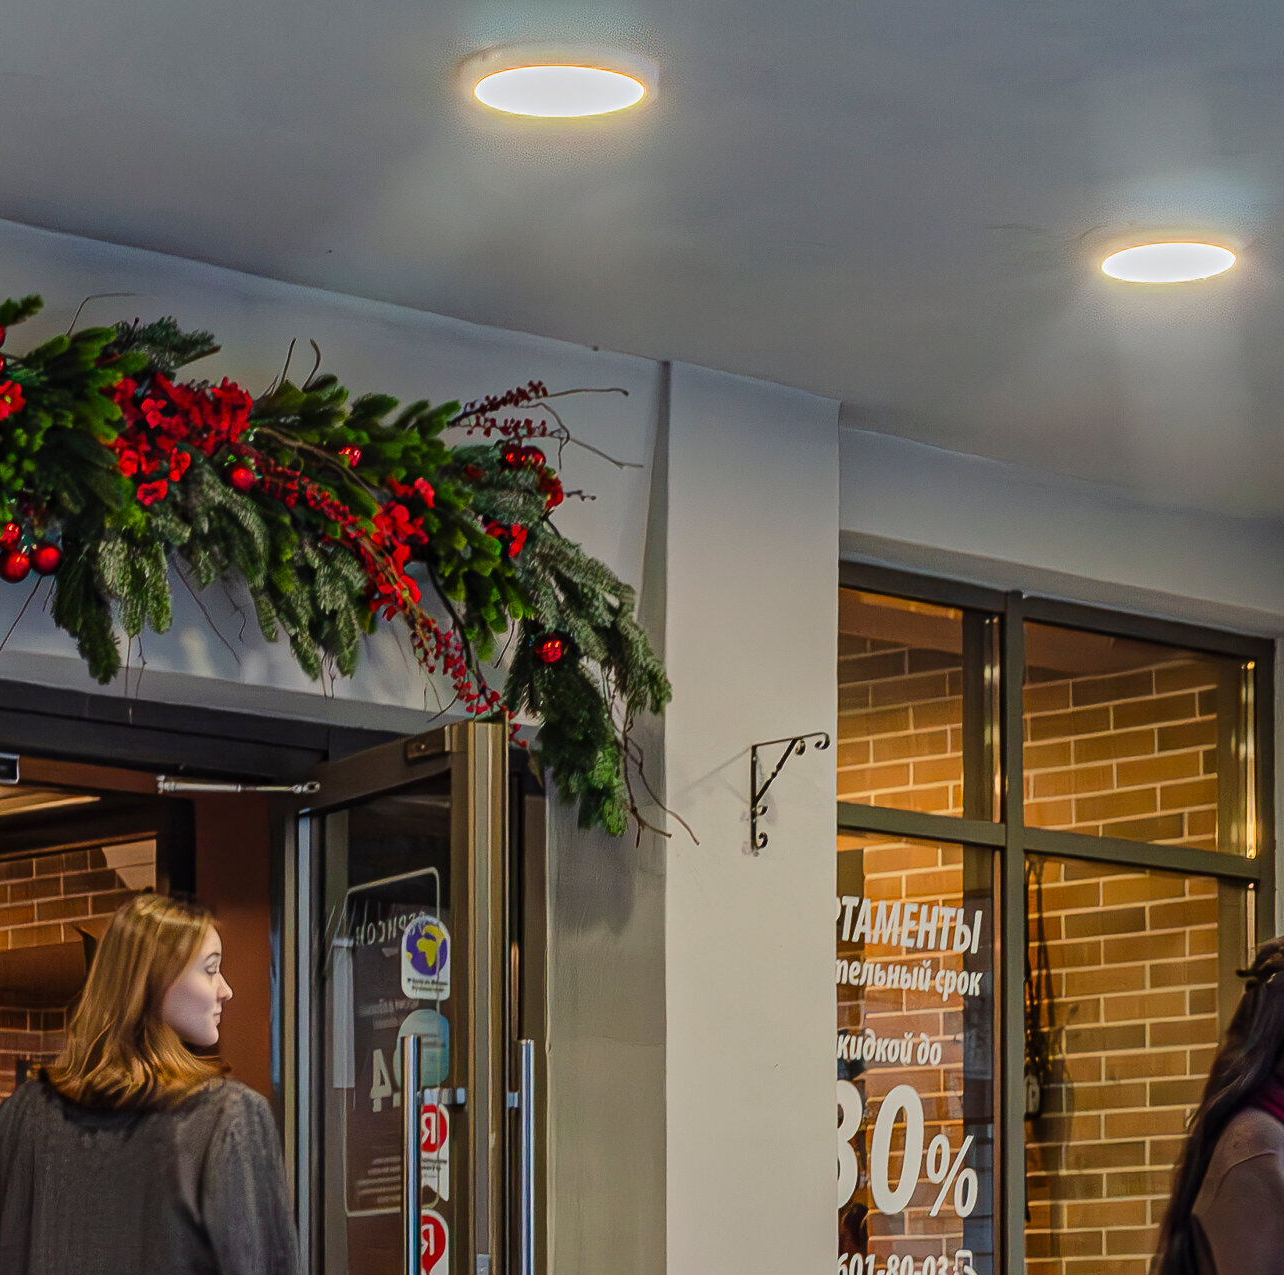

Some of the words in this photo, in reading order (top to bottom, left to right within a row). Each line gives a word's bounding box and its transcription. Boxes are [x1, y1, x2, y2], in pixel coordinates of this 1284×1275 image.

[836, 896, 983, 954] ТАМЕНТЫ
[934, 968, 984, 1002] срок
[917, 1031, 943, 1066] до
